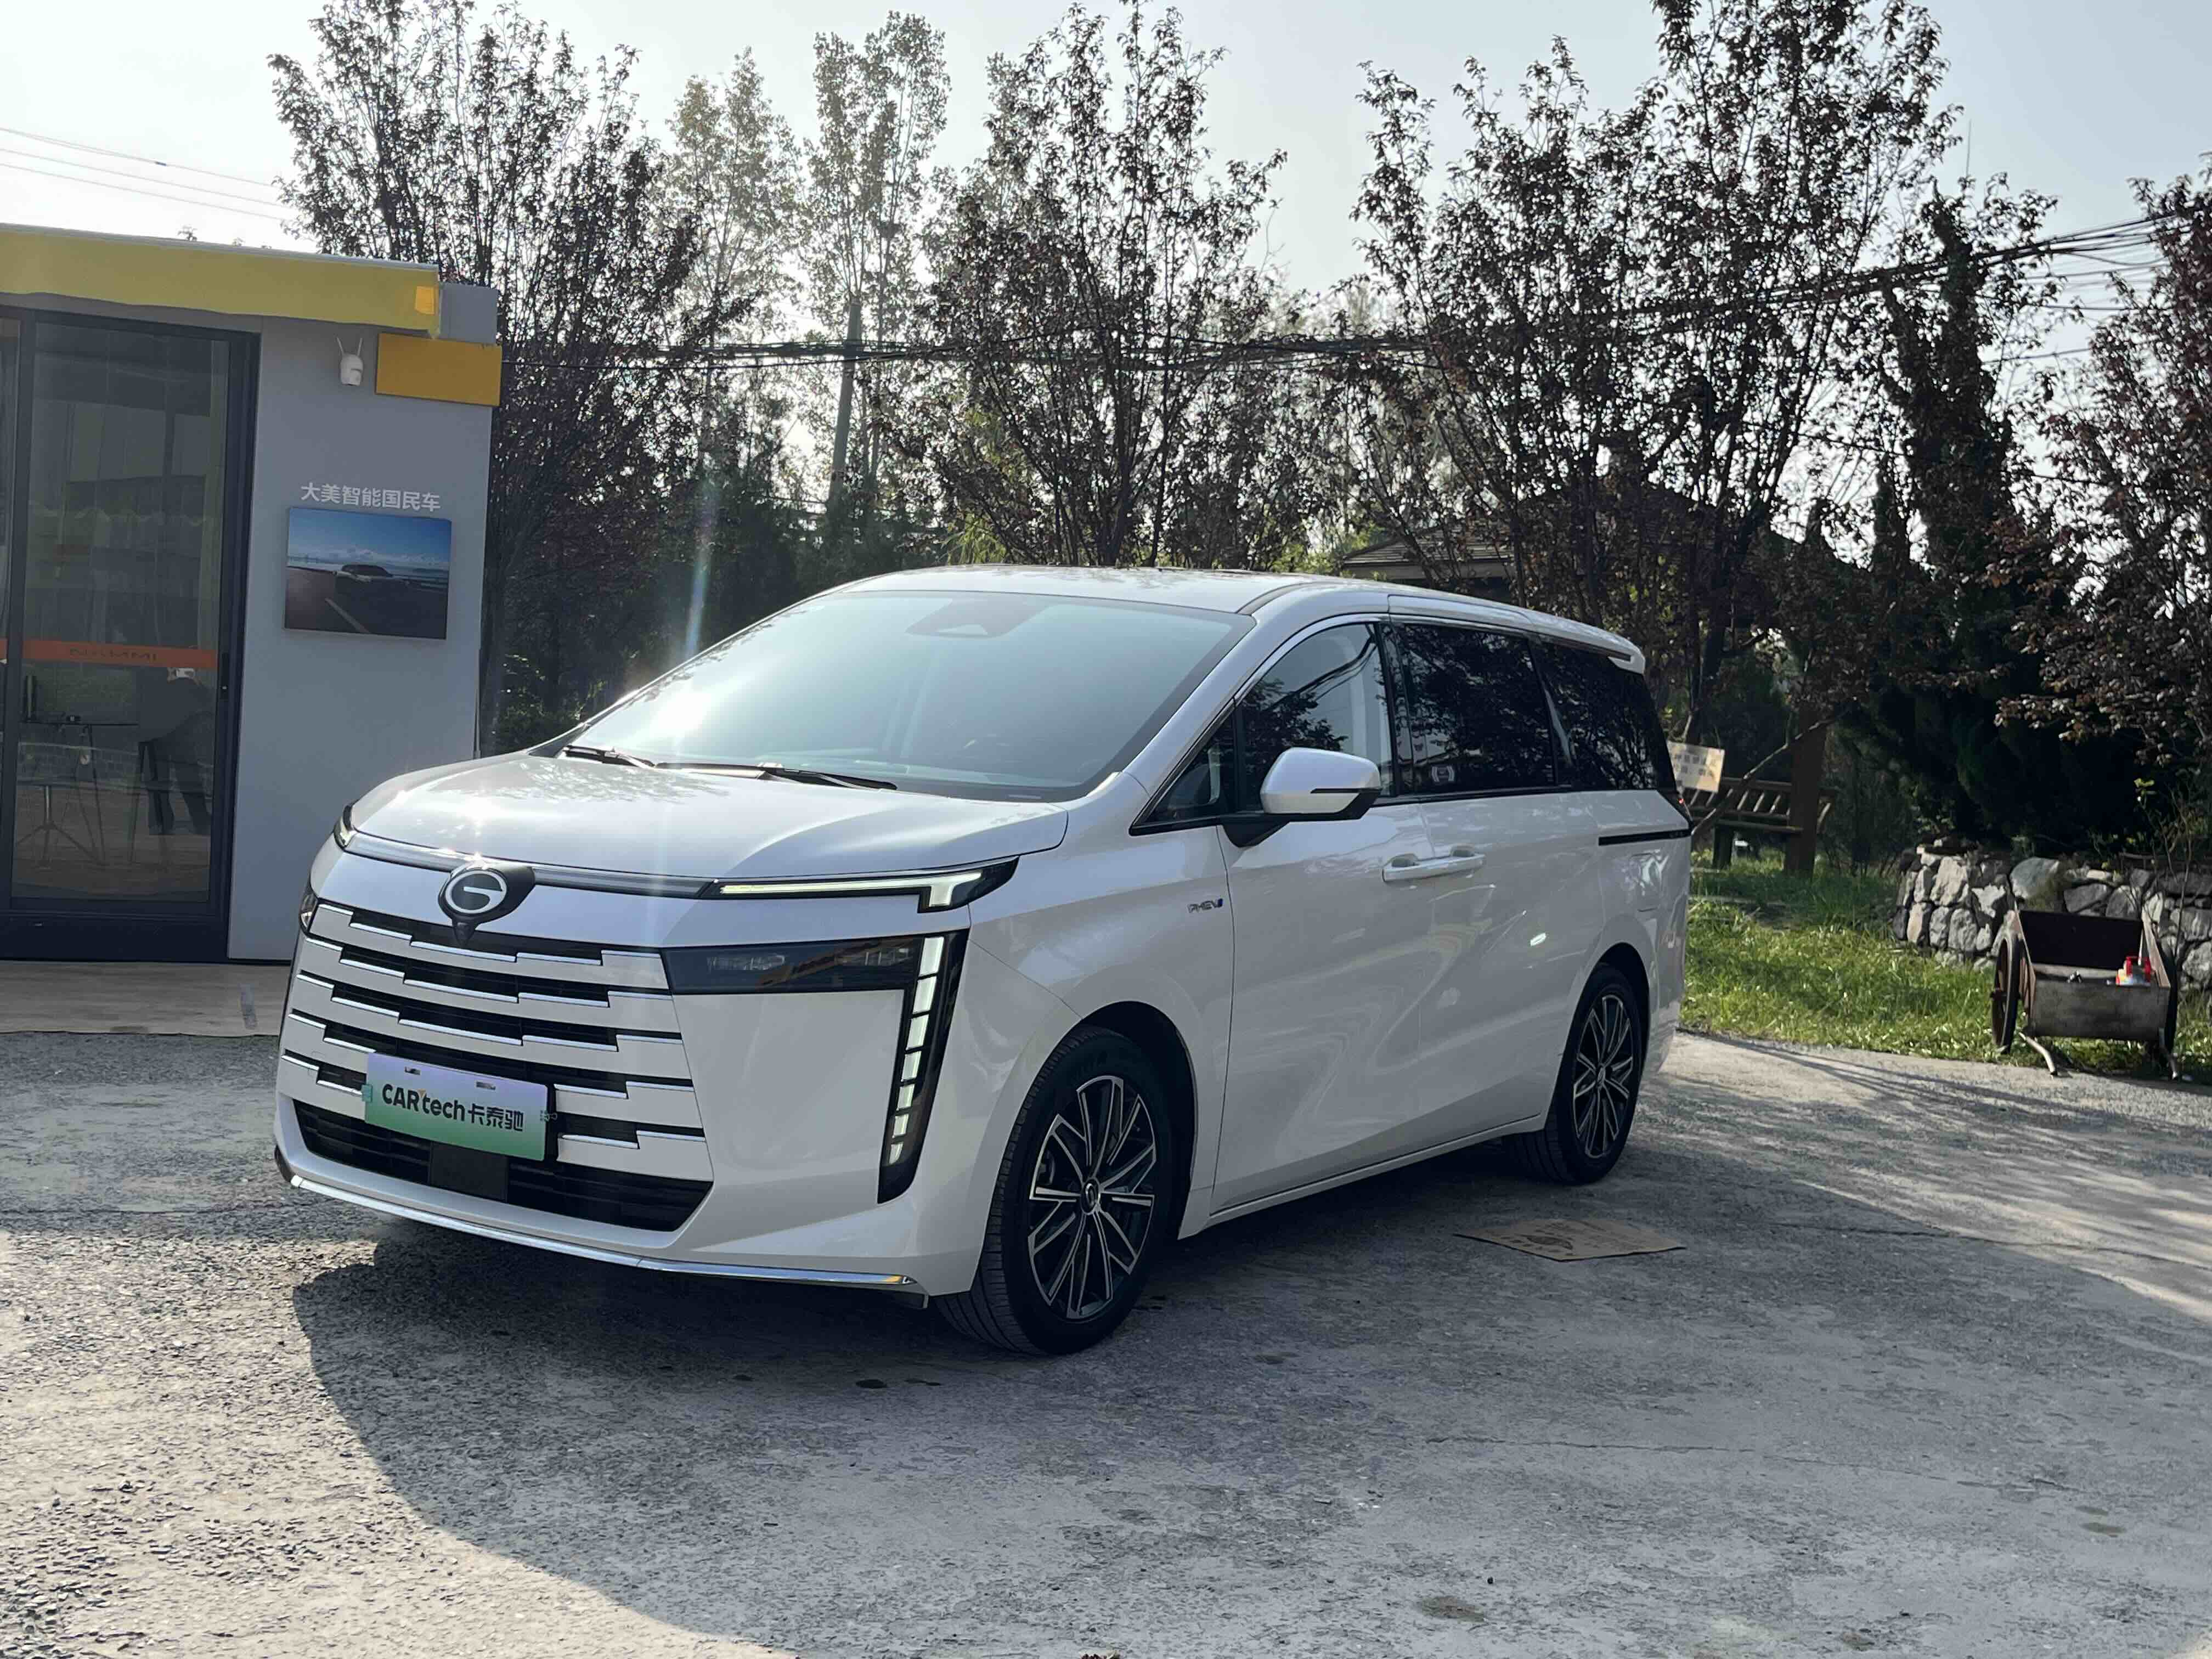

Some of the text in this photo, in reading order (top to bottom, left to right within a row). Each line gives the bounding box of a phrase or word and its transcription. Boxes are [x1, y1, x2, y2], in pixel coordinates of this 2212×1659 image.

[300, 482, 441, 512] 大美智能国民车
